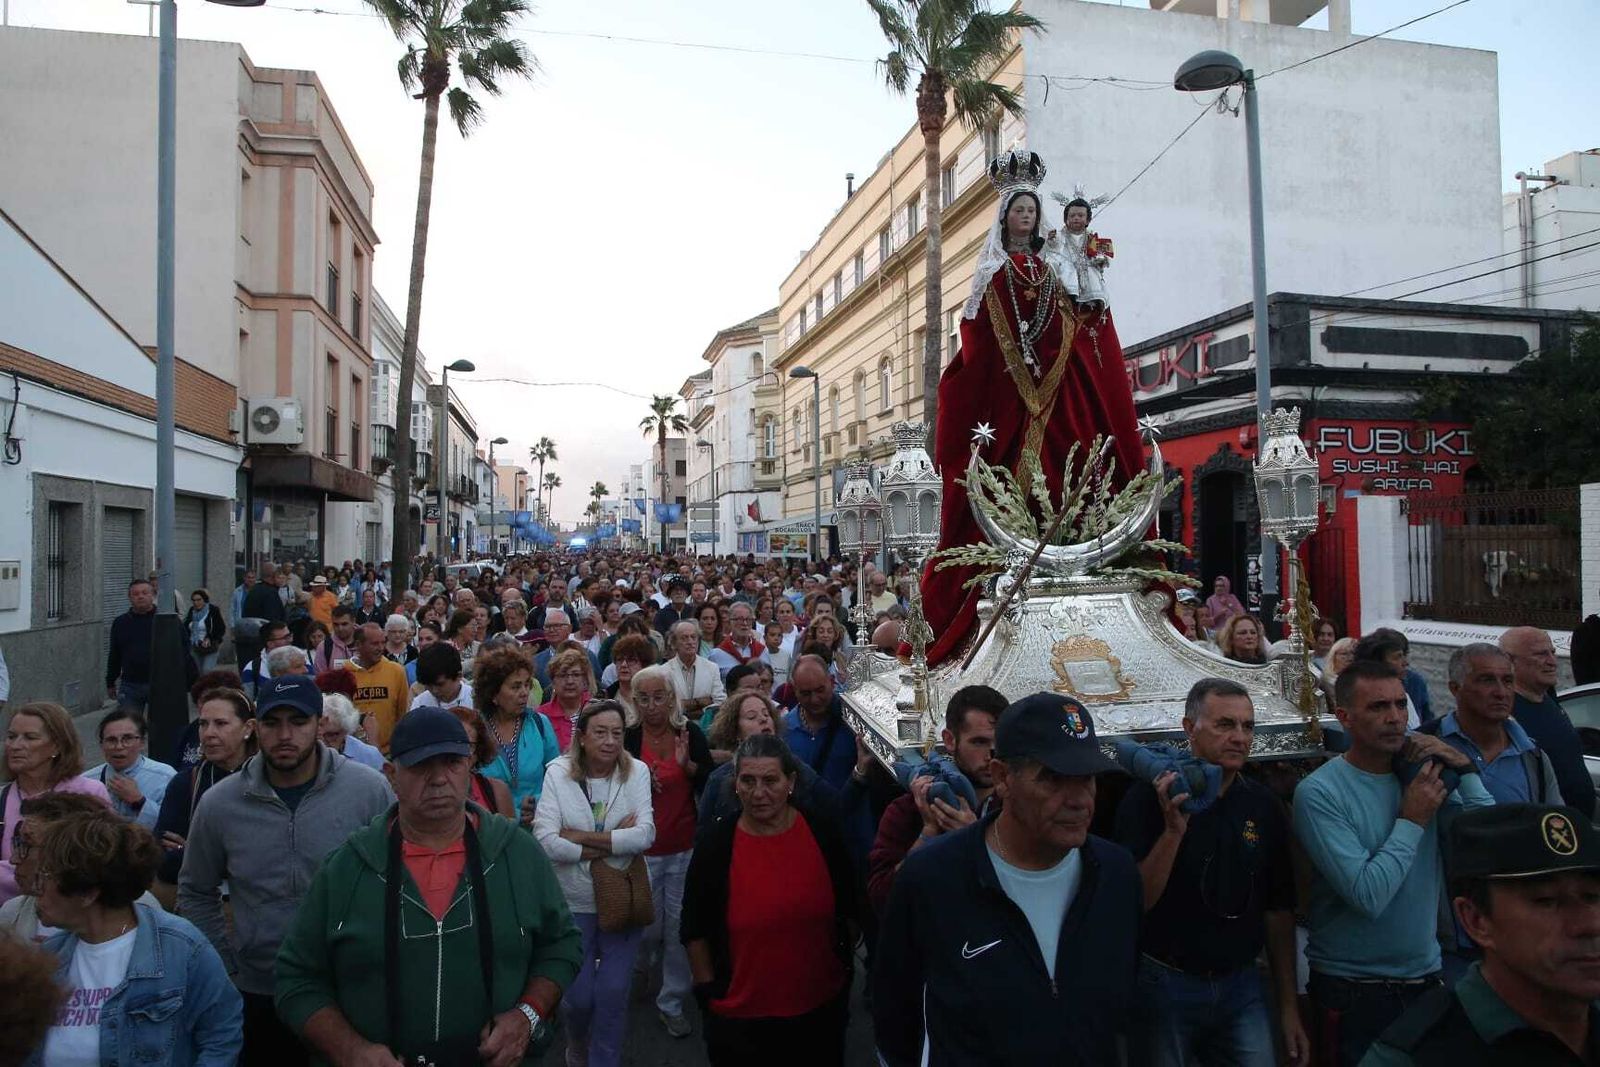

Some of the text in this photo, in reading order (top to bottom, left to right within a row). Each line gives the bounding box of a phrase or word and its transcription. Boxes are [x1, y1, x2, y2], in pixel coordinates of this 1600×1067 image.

[1317, 427, 1474, 455] FUBUKI
[1332, 459, 1460, 474] SUSHI-HAI
[1372, 478, 1433, 490] ARIFA
[1403, 626, 1501, 641] tarifatwentytwen
